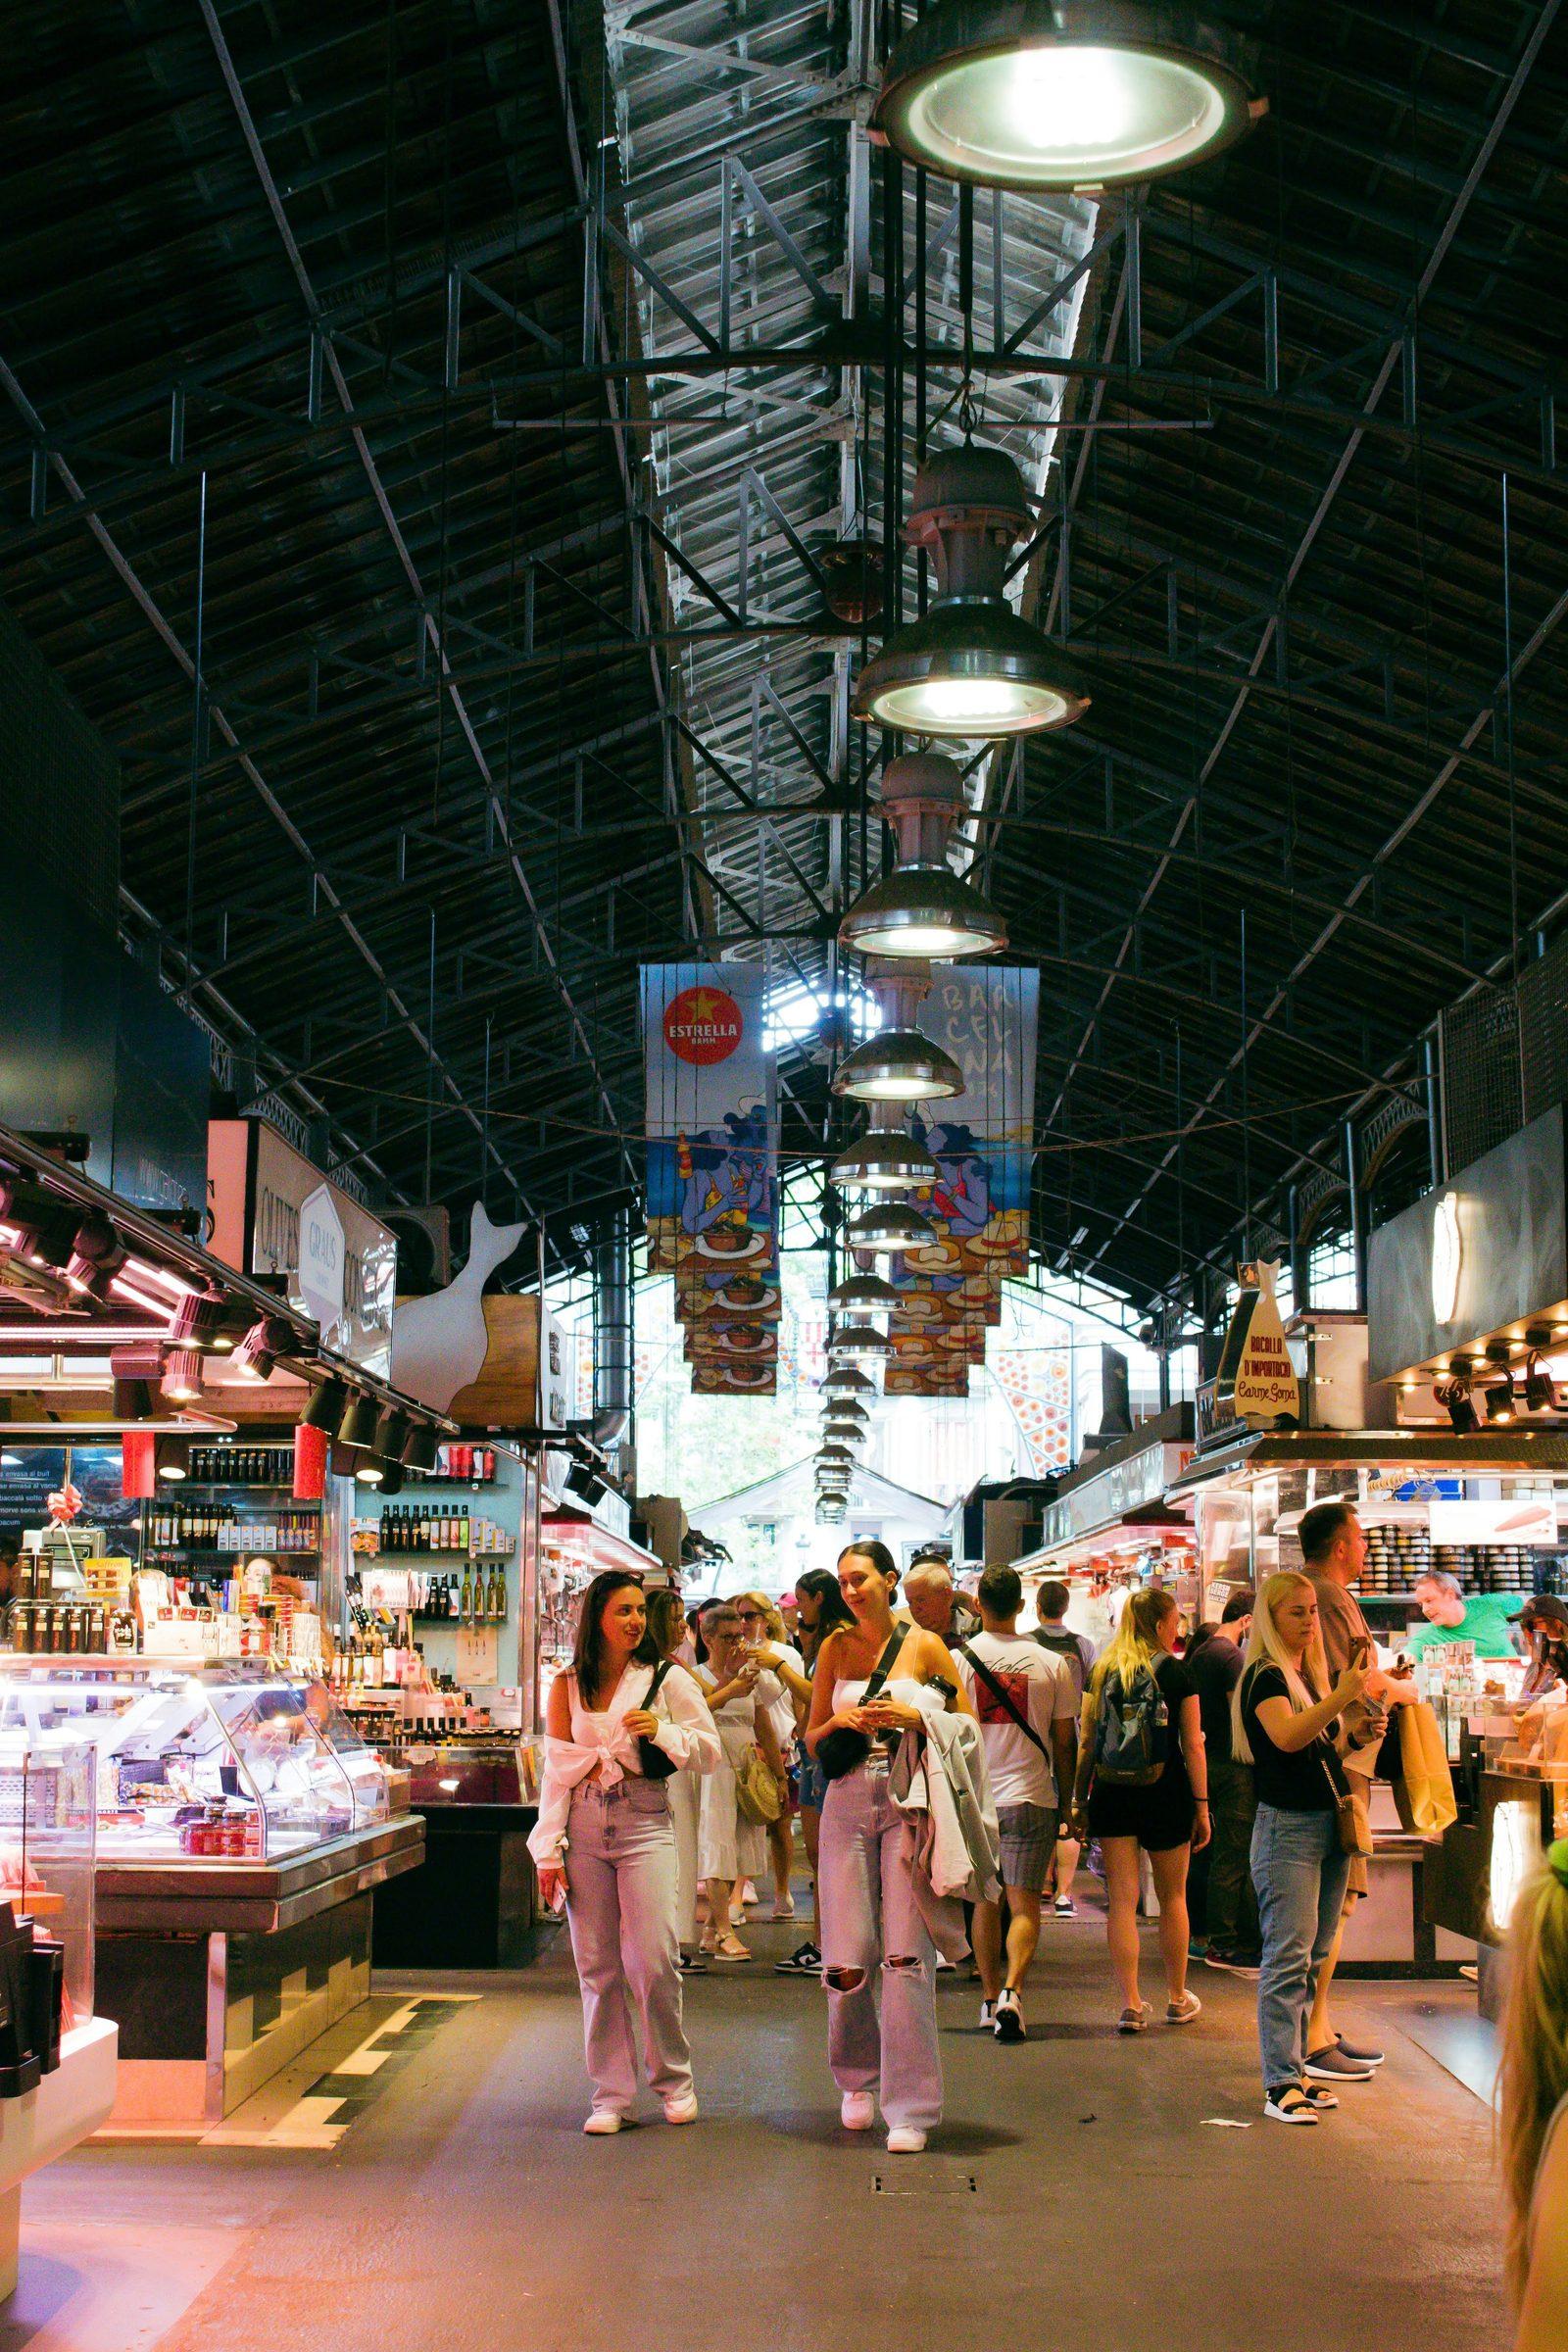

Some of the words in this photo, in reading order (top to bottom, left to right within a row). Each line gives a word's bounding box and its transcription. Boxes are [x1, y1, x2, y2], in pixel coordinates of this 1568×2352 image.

[942, 985, 1012, 1010] BAR
[669, 1024, 737, 1038] ESTRELLA
[947, 1015, 1012, 1043] CEL
[1239, 1381, 1269, 1401] Carme
